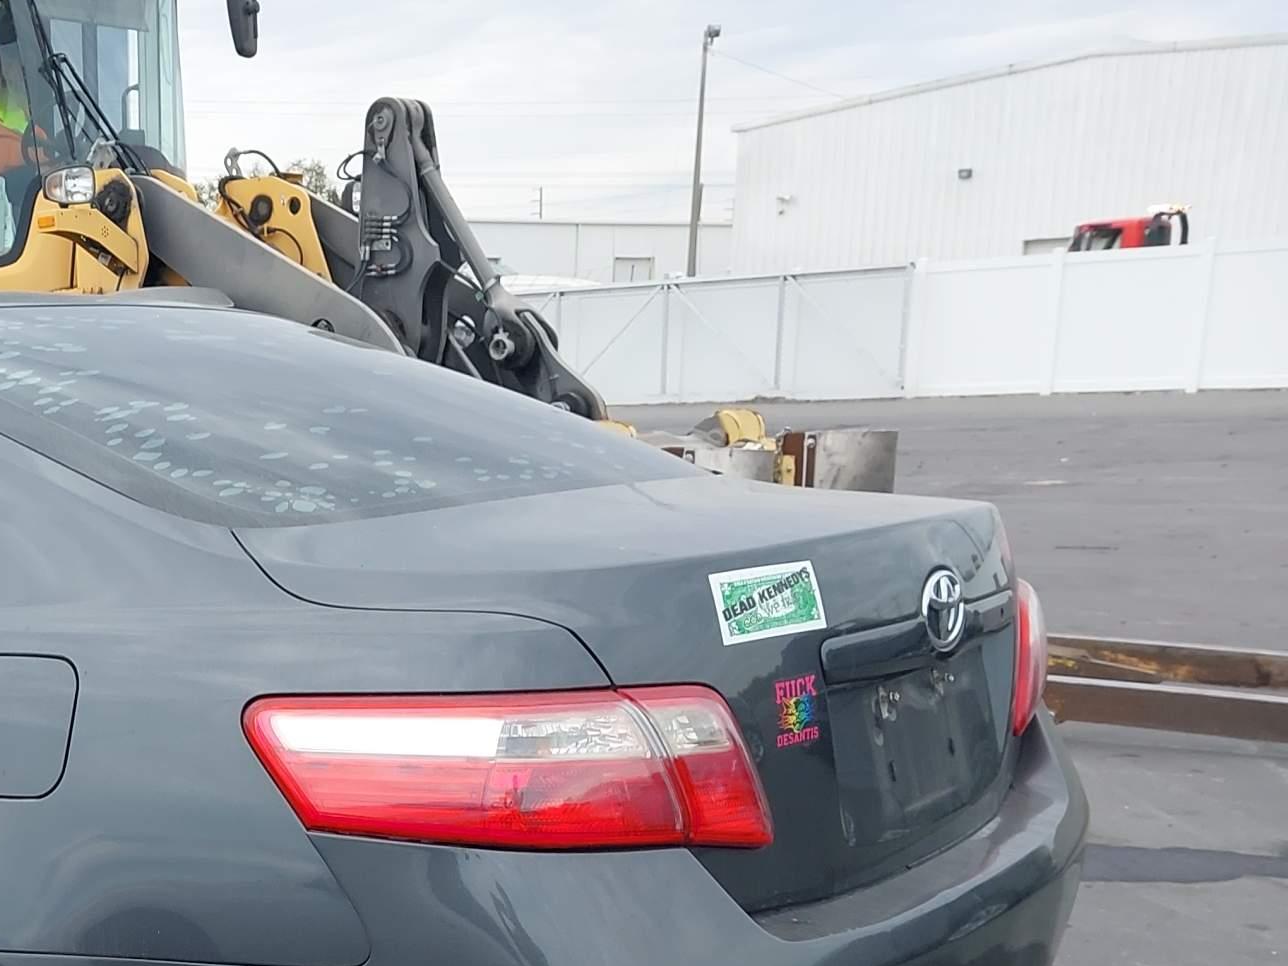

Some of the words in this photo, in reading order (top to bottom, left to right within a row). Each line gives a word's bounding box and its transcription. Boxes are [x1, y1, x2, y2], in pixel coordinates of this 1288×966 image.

[722, 597, 756, 622] DEAD
[758, 567, 810, 604] KENNEDYS
[775, 674, 817, 705] FUCK
[777, 726, 819, 748] DESANTIS
